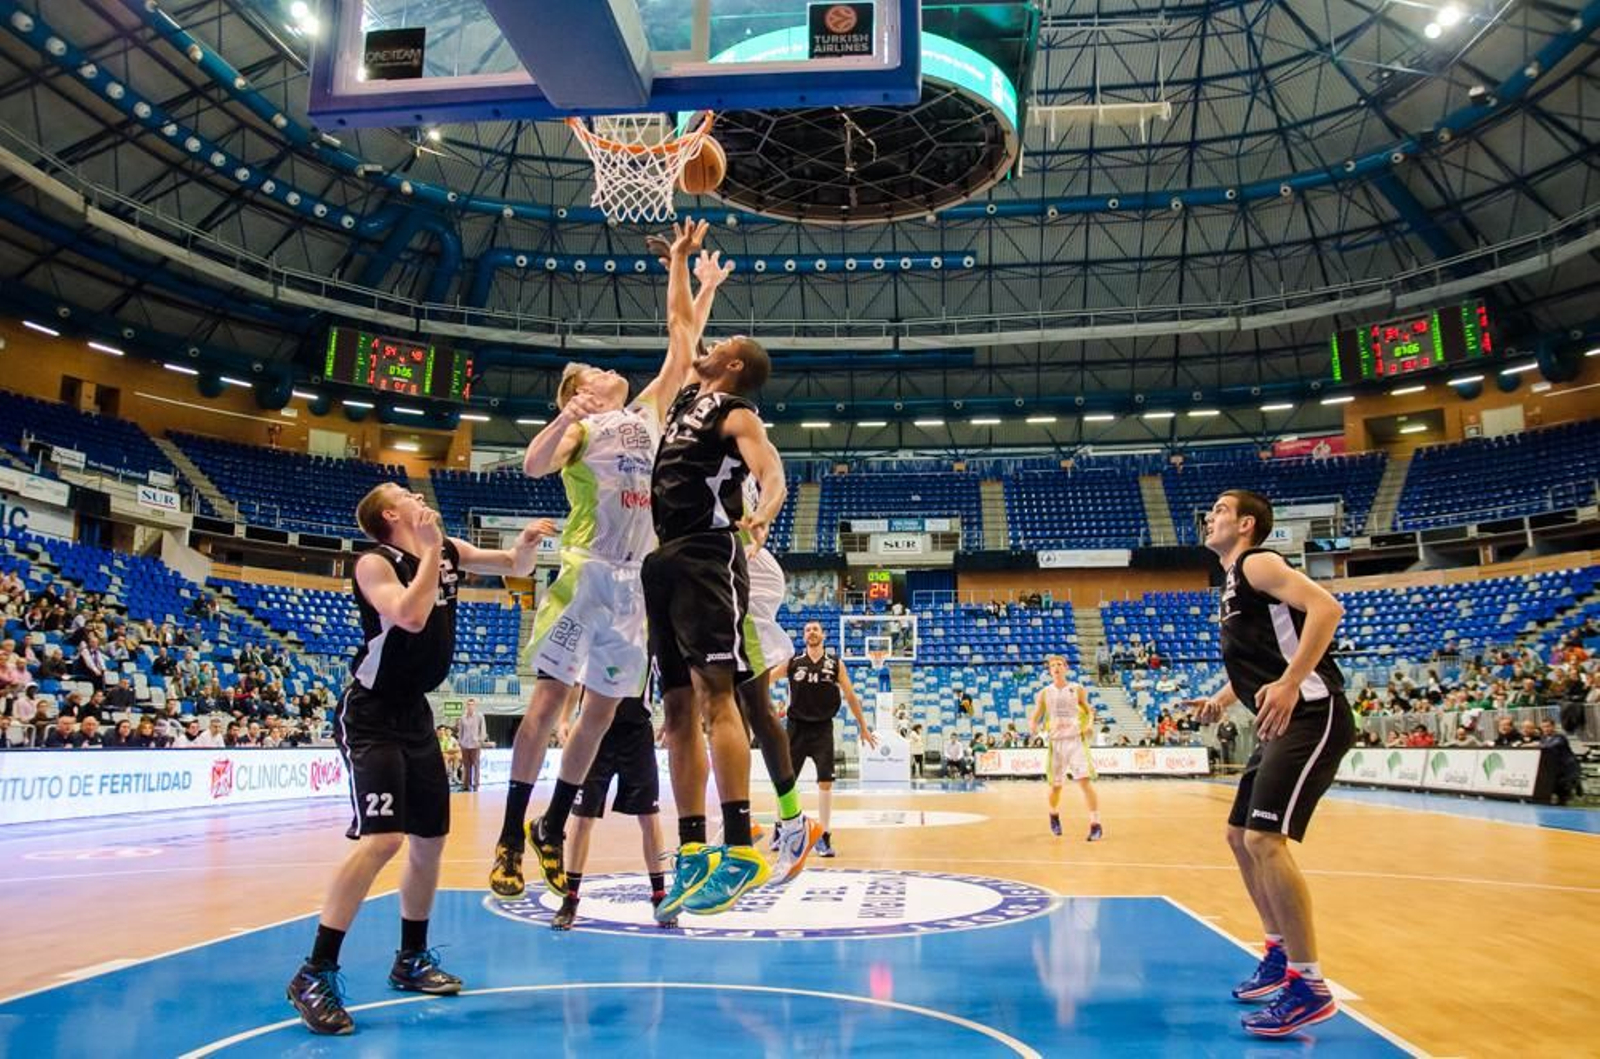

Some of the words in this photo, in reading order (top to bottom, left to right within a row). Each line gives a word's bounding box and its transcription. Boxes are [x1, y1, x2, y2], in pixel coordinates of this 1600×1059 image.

[814, 34, 869, 44] TURKISH
[814, 43, 870, 53] AIRLINES
[141, 489, 175, 506] SUR
[883, 541, 917, 549] SUR
[870, 583, 888, 598] 24
[69, 775, 94, 797] DE
[99, 770, 192, 795] FERTILIDAD
[236, 763, 308, 791] CLINICAS
[366, 793, 394, 817] 22
